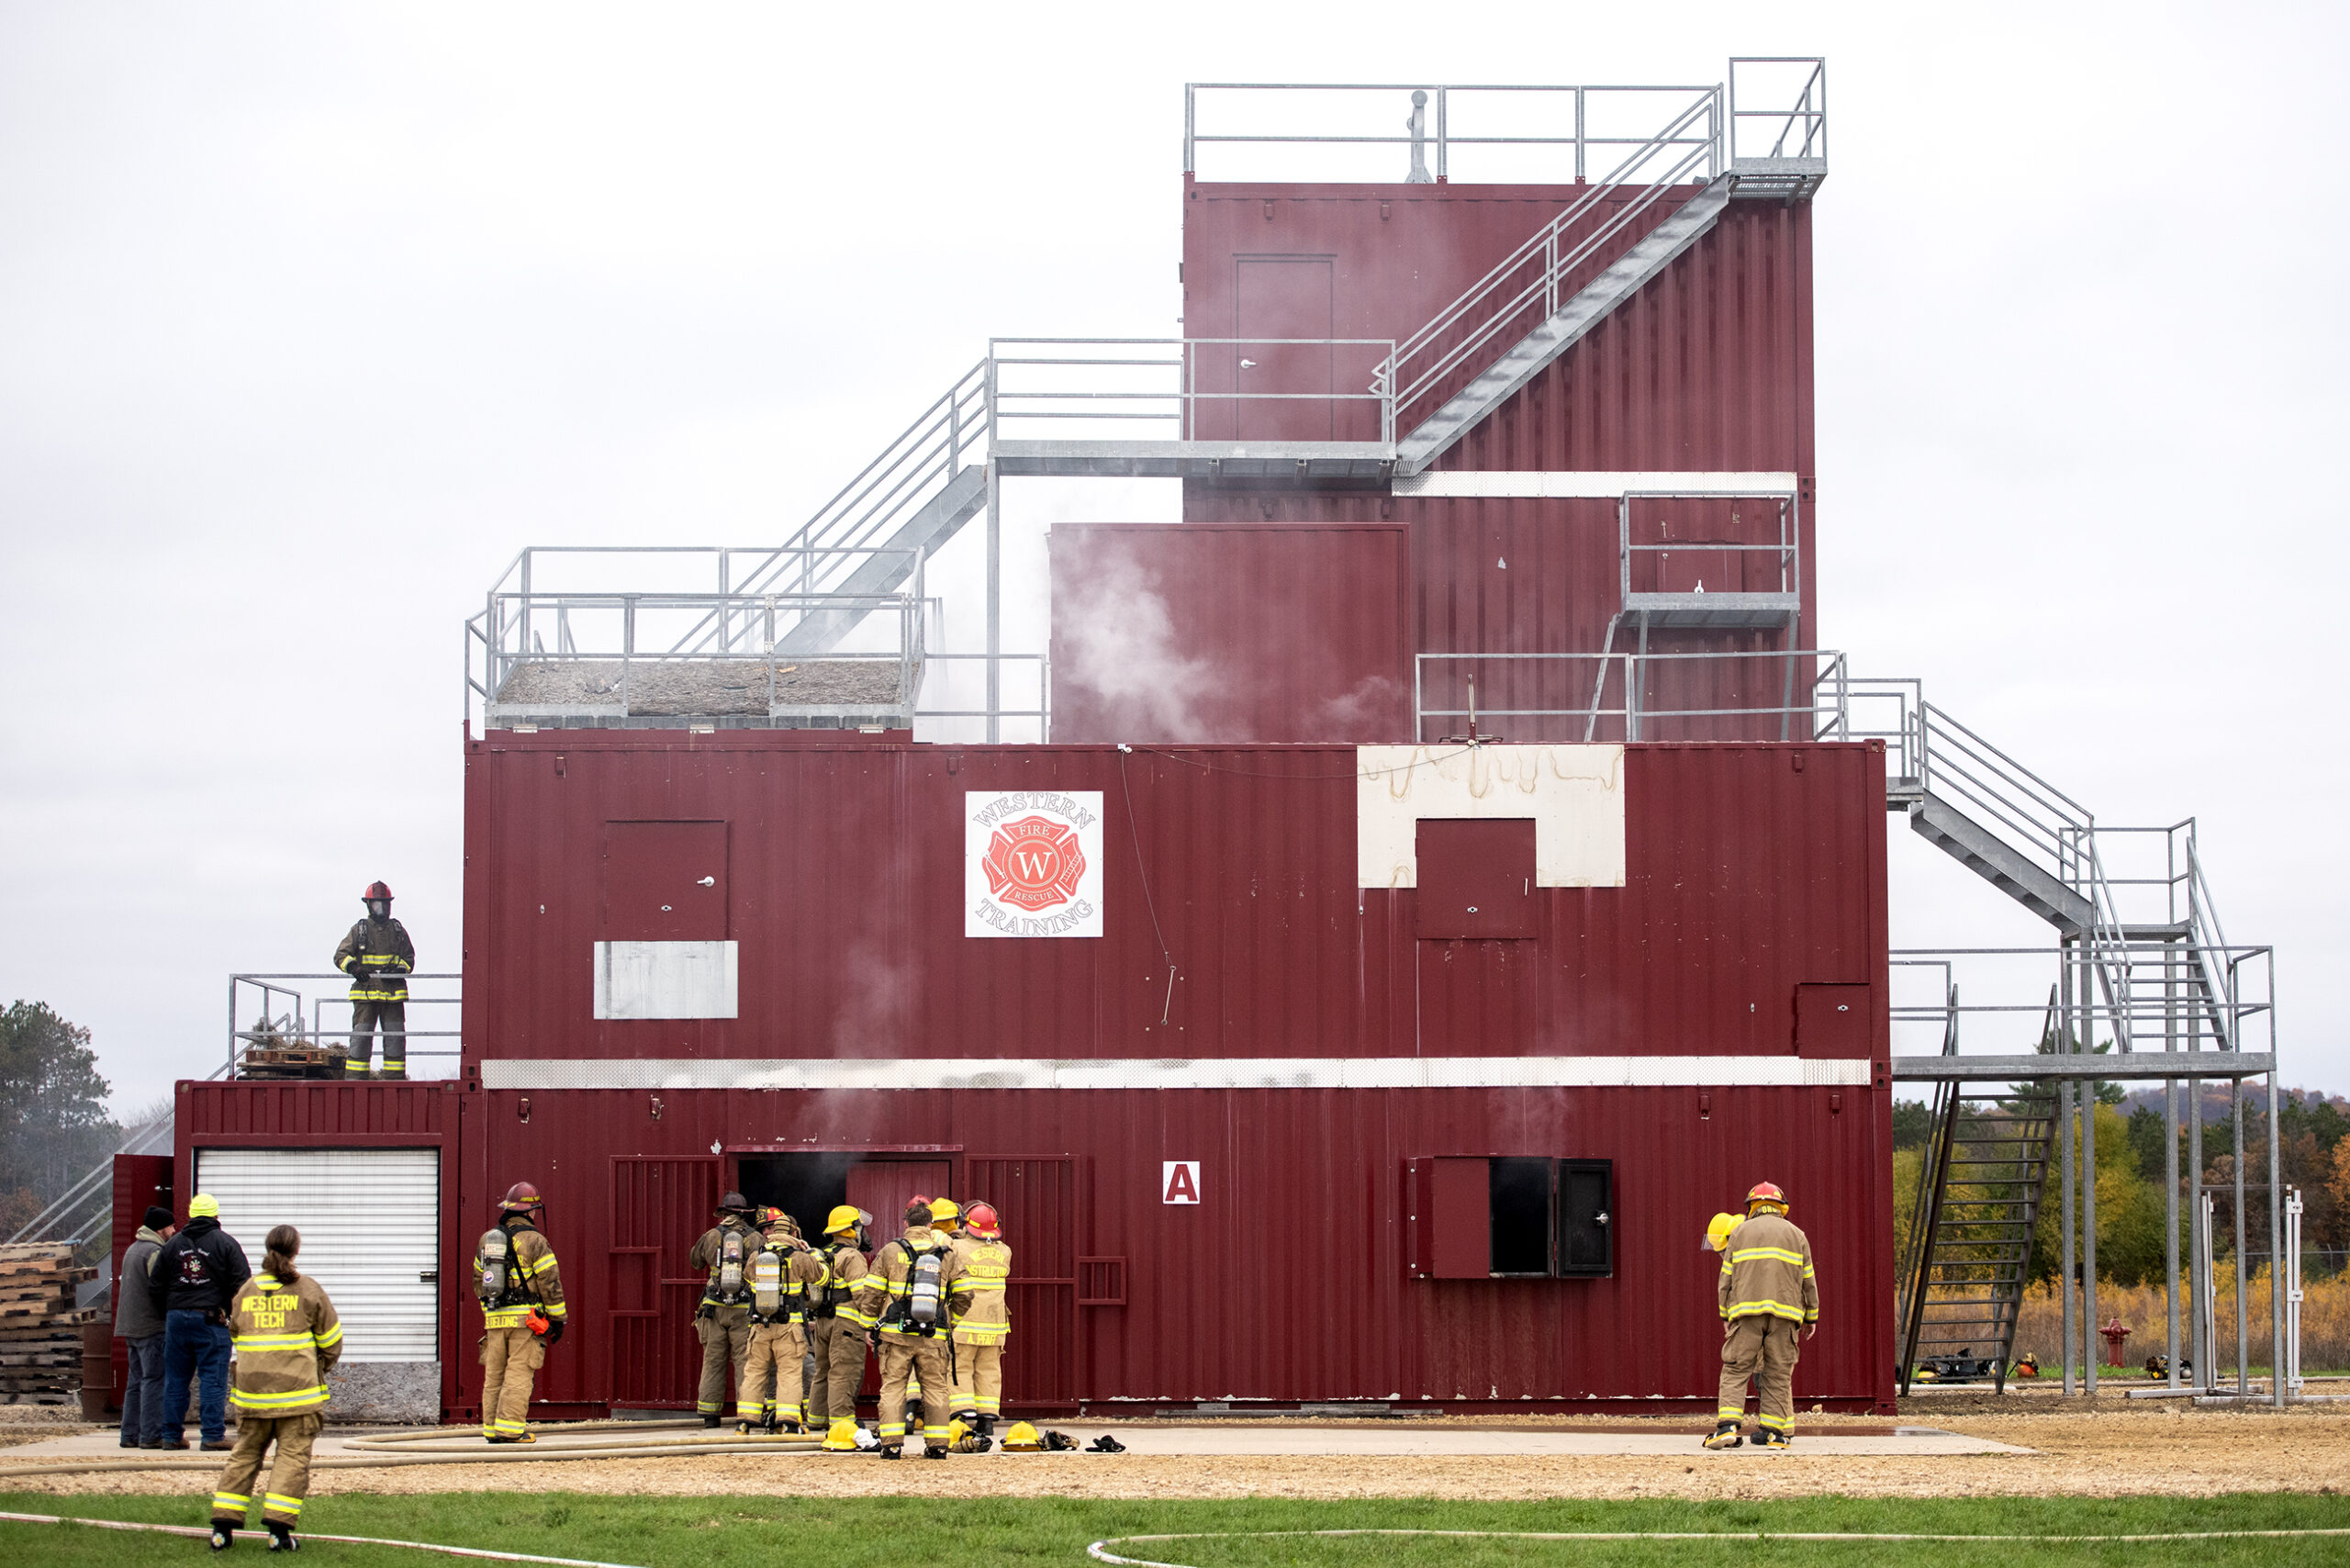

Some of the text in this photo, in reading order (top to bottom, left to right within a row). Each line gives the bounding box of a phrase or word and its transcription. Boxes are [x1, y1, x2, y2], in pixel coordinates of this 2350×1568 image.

[973, 791, 1096, 830] WESTERN
[1019, 824, 1050, 836] FIRE
[1015, 851, 1053, 880] W
[1014, 891, 1055, 902] RESCUE
[975, 897, 1094, 936] TRAINING
[1165, 1163, 1198, 1202] A
[969, 1247, 1005, 1264] WESTERN
[241, 1294, 299, 1312] WESTERN
[253, 1311, 285, 1328] TECH
